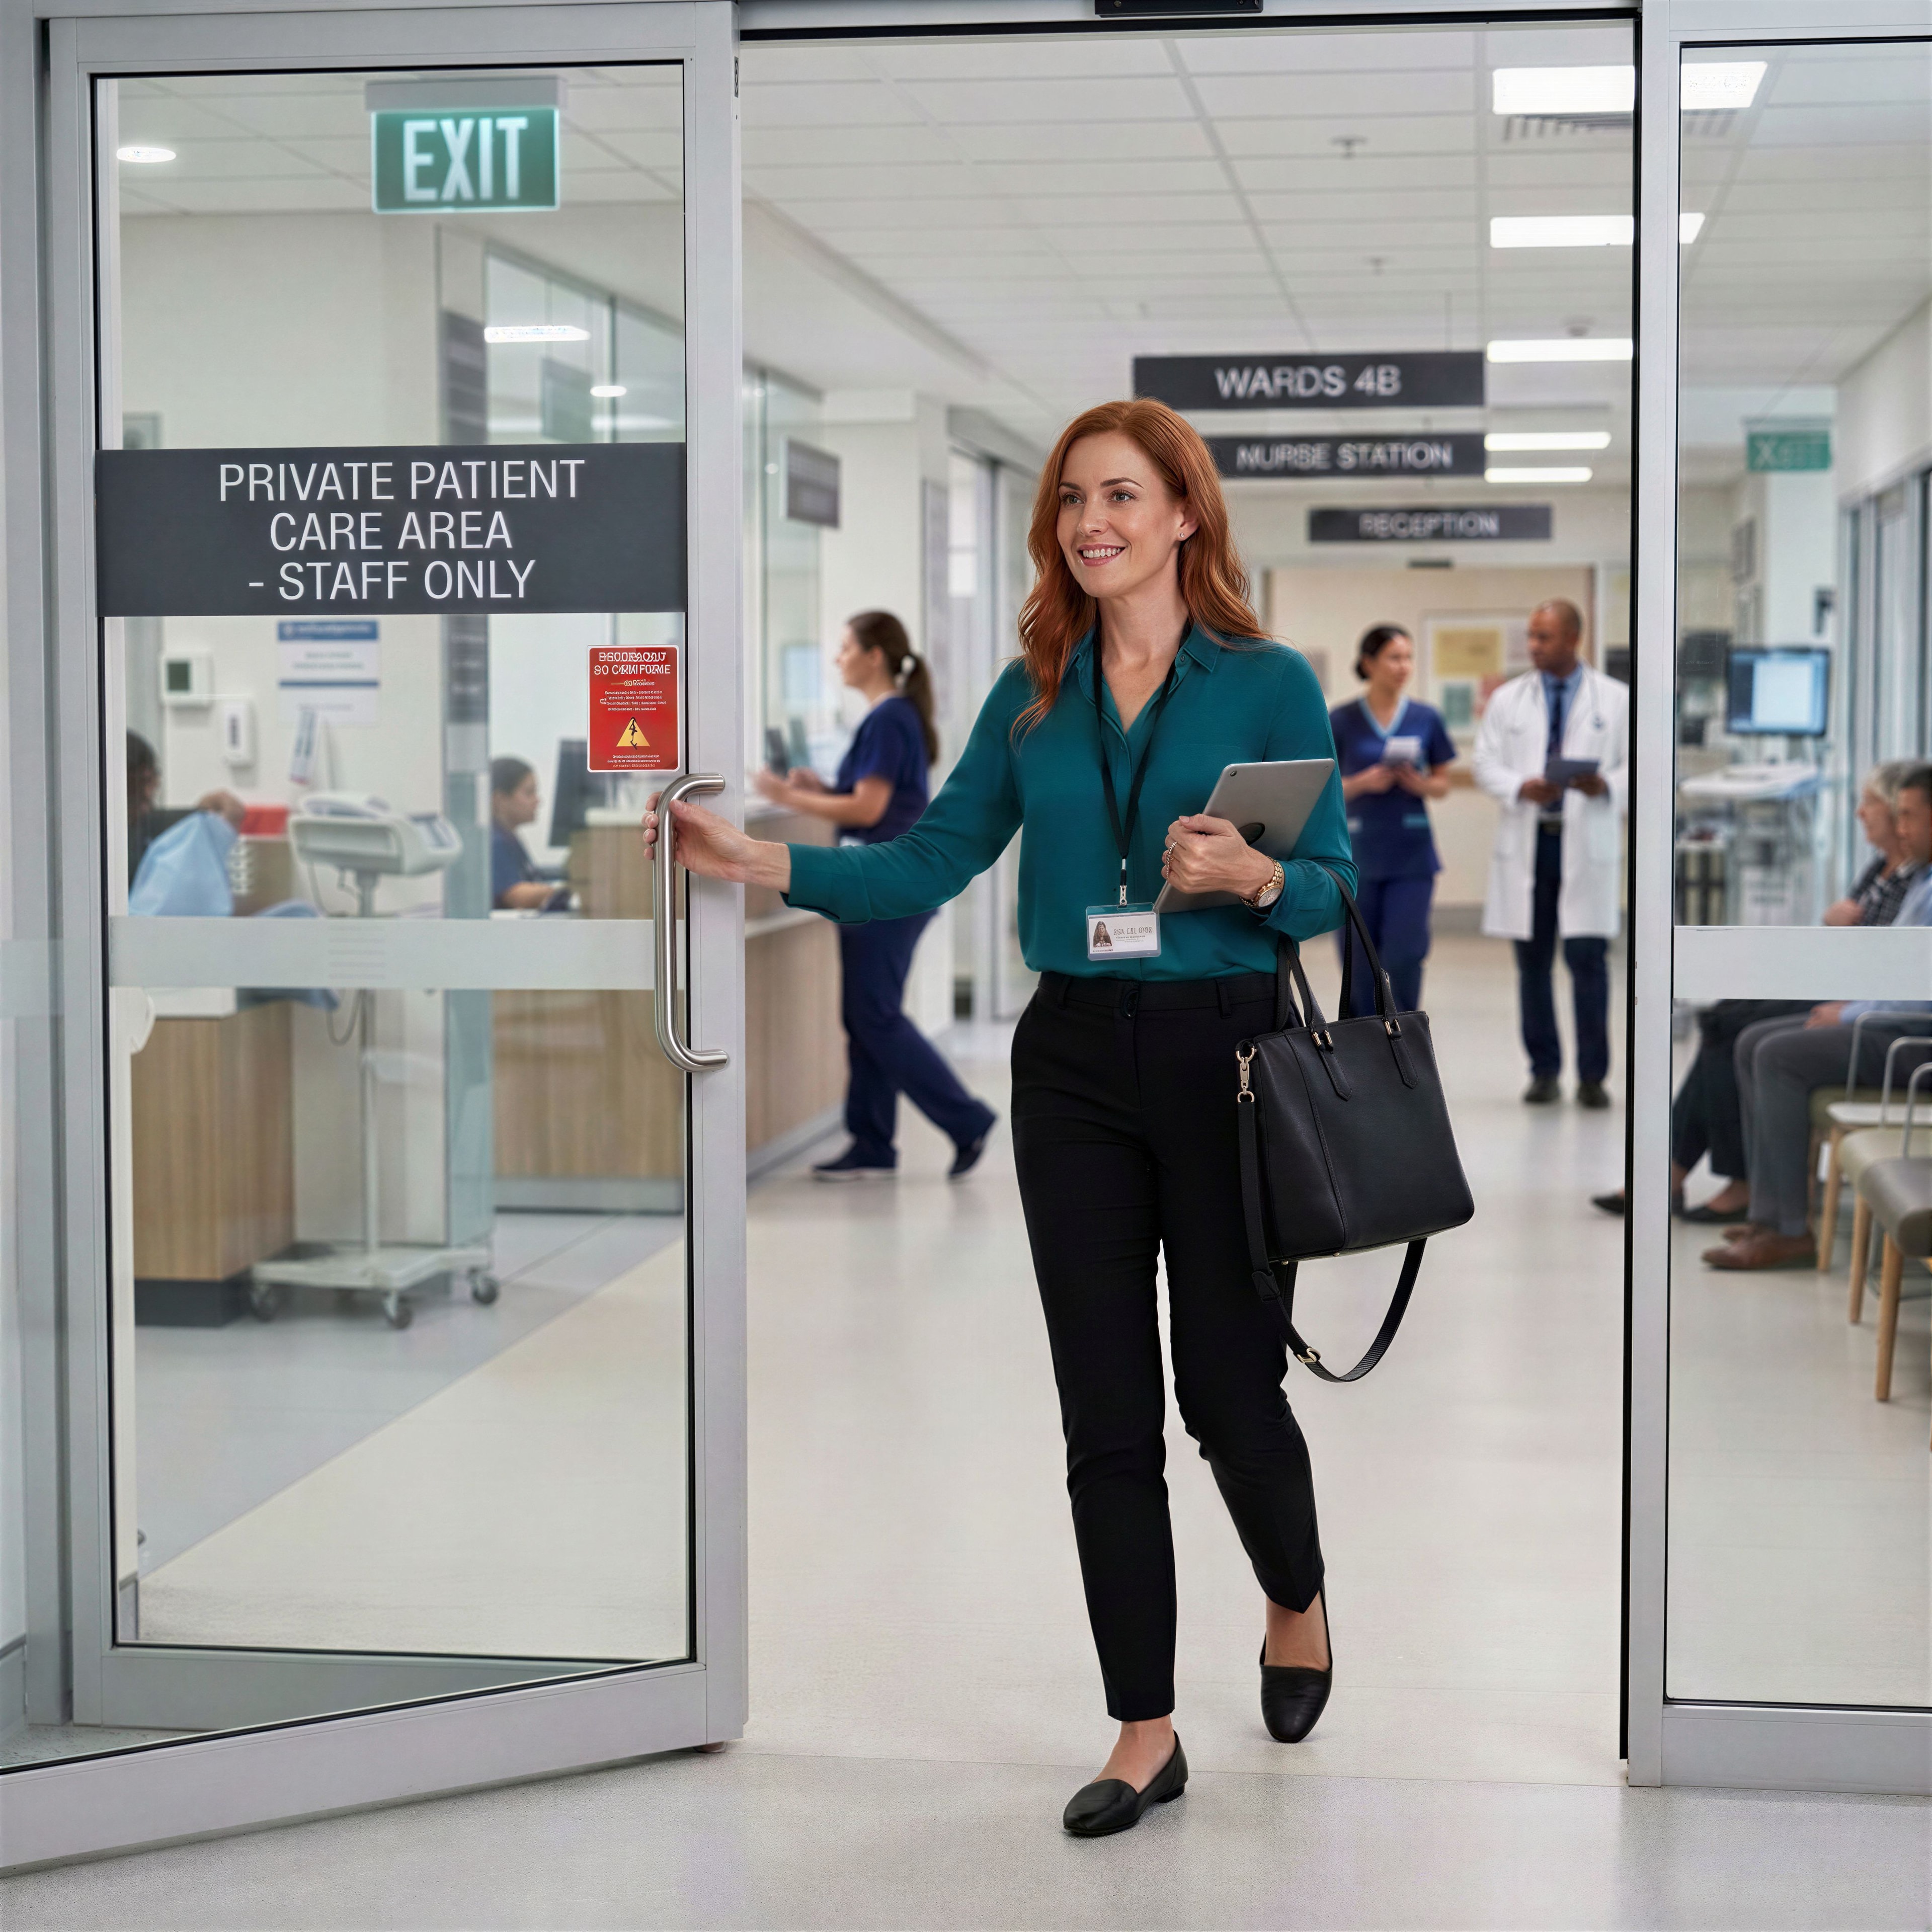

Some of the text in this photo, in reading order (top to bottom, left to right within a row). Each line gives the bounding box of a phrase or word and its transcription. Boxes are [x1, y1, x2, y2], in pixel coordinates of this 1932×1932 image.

[404, 116, 528, 201] EXIT
[1215, 365, 1401, 398] WARDS 4B
[1337, 442, 1453, 469] STATION
[220, 459, 585, 502] PRIVATE PATIENT
[270, 511, 513, 551] CARE AREA
[1359, 511, 1499, 538] RECEPTION
[279, 561, 409, 600] STAFF
[424, 559, 536, 599] ONLY
